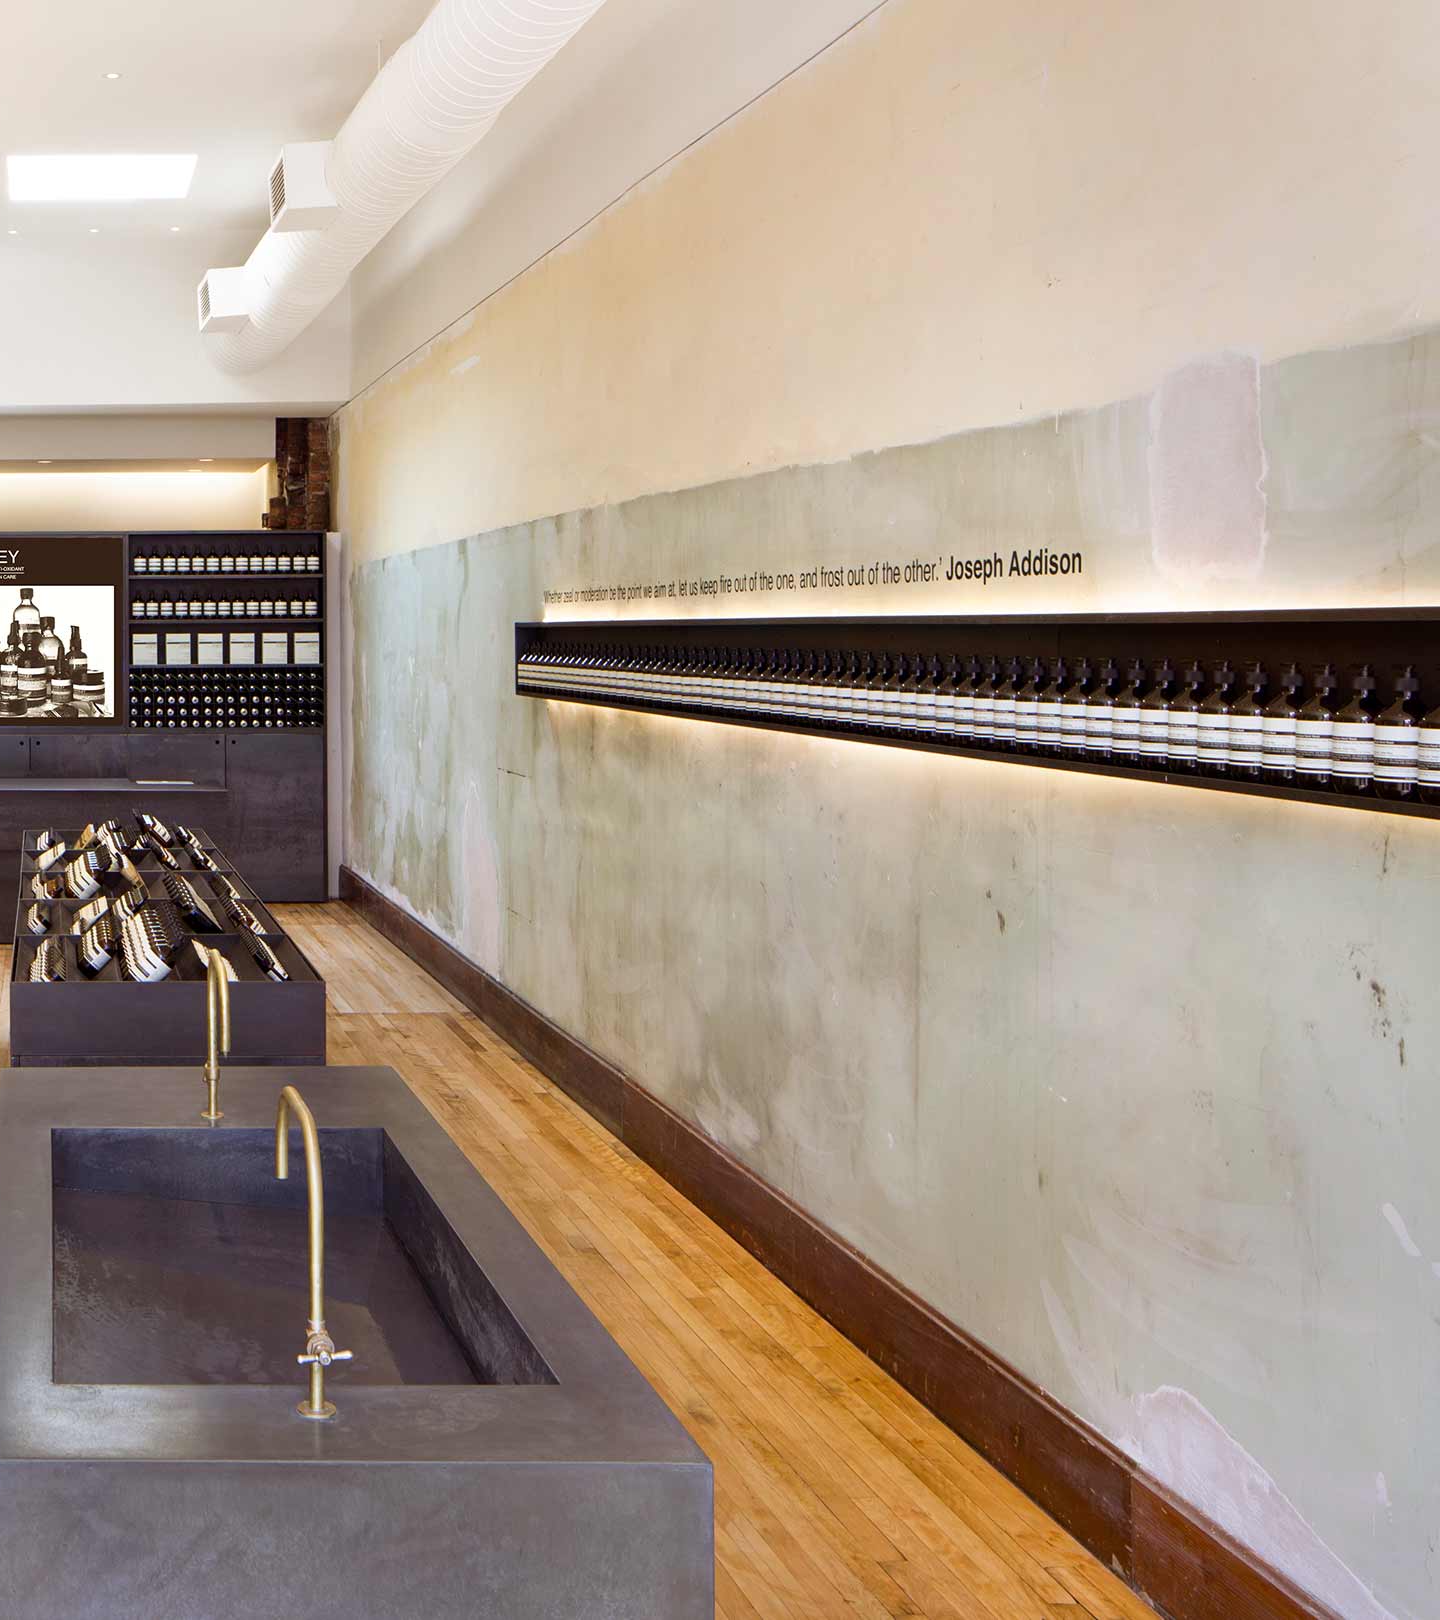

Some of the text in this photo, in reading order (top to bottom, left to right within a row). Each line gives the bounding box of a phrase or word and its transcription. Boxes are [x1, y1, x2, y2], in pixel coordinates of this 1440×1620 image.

[627, 583, 642, 604] point
[643, 585, 652, 599] we
[654, 580, 666, 599] aim
[679, 579, 688, 597] let
[689, 582, 698, 596] us
[700, 577, 718, 598] keep
[720, 575, 732, 593] fire
[734, 575, 747, 592] out
[749, 572, 758, 592] of
[760, 571, 773, 591] the
[776, 573, 797, 592] one,
[800, 568, 817, 588] and
[820, 566, 844, 587] frost
[847, 565, 864, 586] out
[868, 562, 879, 585] of
[882, 561, 900, 584] the
[946, 552, 1003, 585] Joseph
[1009, 548, 1082, 577] Addison
